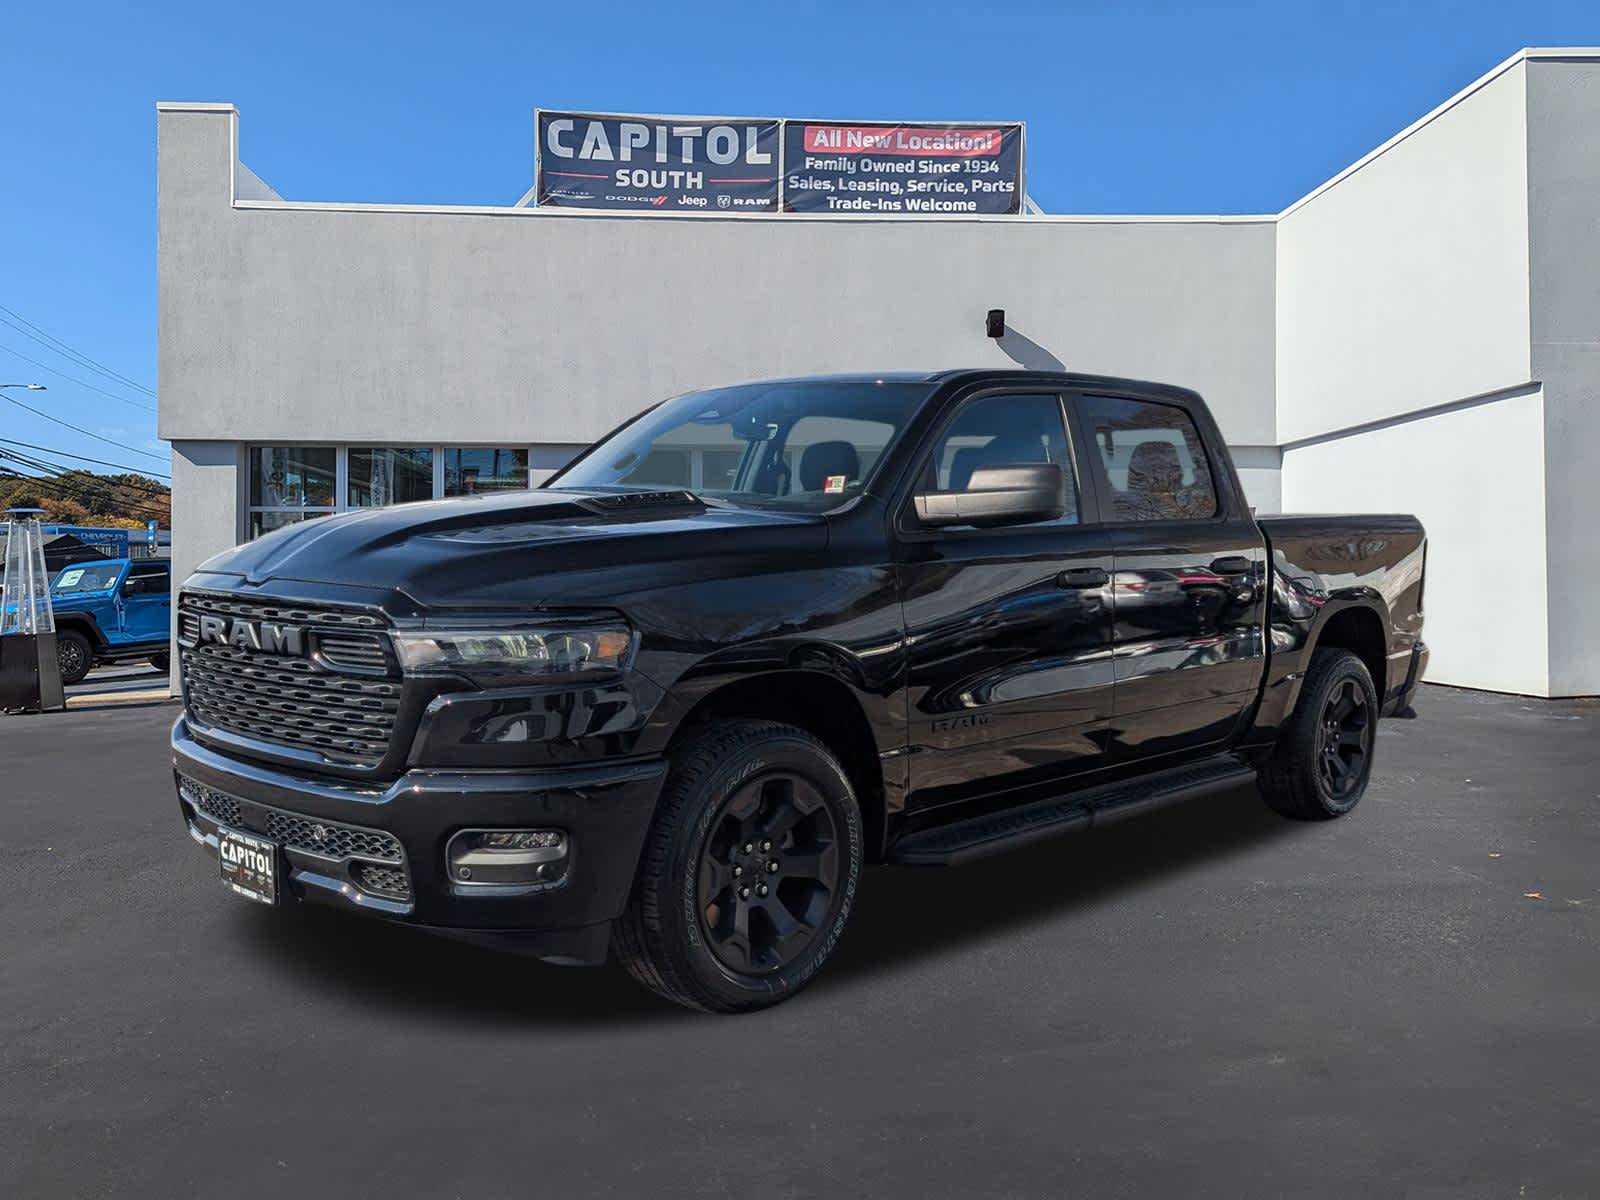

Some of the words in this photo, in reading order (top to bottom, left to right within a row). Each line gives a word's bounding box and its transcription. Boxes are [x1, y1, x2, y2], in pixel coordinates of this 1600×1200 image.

[547, 119, 772, 165] CAPITOL
[813, 129, 841, 148] All
[847, 131, 892, 149] New
[896, 132, 993, 152] Location!
[805, 157, 857, 174] Family
[860, 158, 914, 173] Owned
[918, 160, 961, 174] Since
[963, 160, 1000, 174] 1934
[615, 169, 703, 190] SOUTH
[789, 176, 835, 192] Sales,
[839, 178, 904, 195] Leasing,
[907, 179, 968, 195] Service,
[972, 180, 1015, 193] Parts
[677, 195, 708, 207] Jeep
[827, 196, 902, 211] Trade-Ins
[906, 197, 977, 212] Welcome
[200, 615, 305, 657] RAM
[220, 840, 273, 877] CAPITOL
